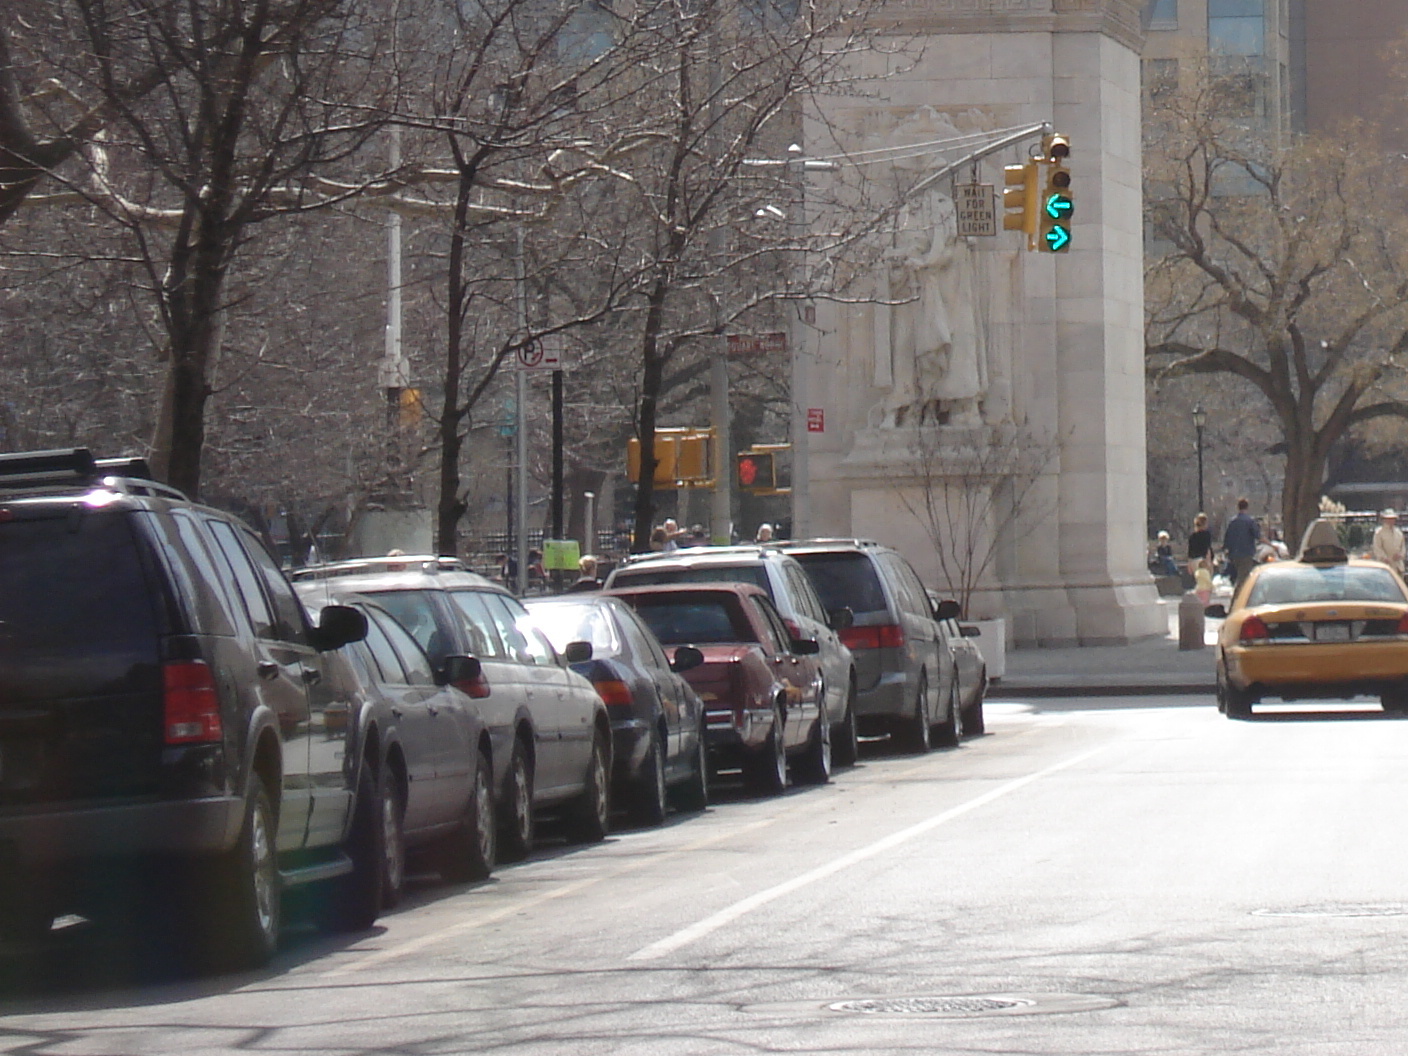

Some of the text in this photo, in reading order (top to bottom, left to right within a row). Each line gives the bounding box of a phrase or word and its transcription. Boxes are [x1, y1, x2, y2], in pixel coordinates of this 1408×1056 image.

[963, 187, 985, 198] WAIT
[966, 199, 985, 209] FOR
[960, 210, 992, 221] GREEN
[962, 222, 990, 233] LIGHT
